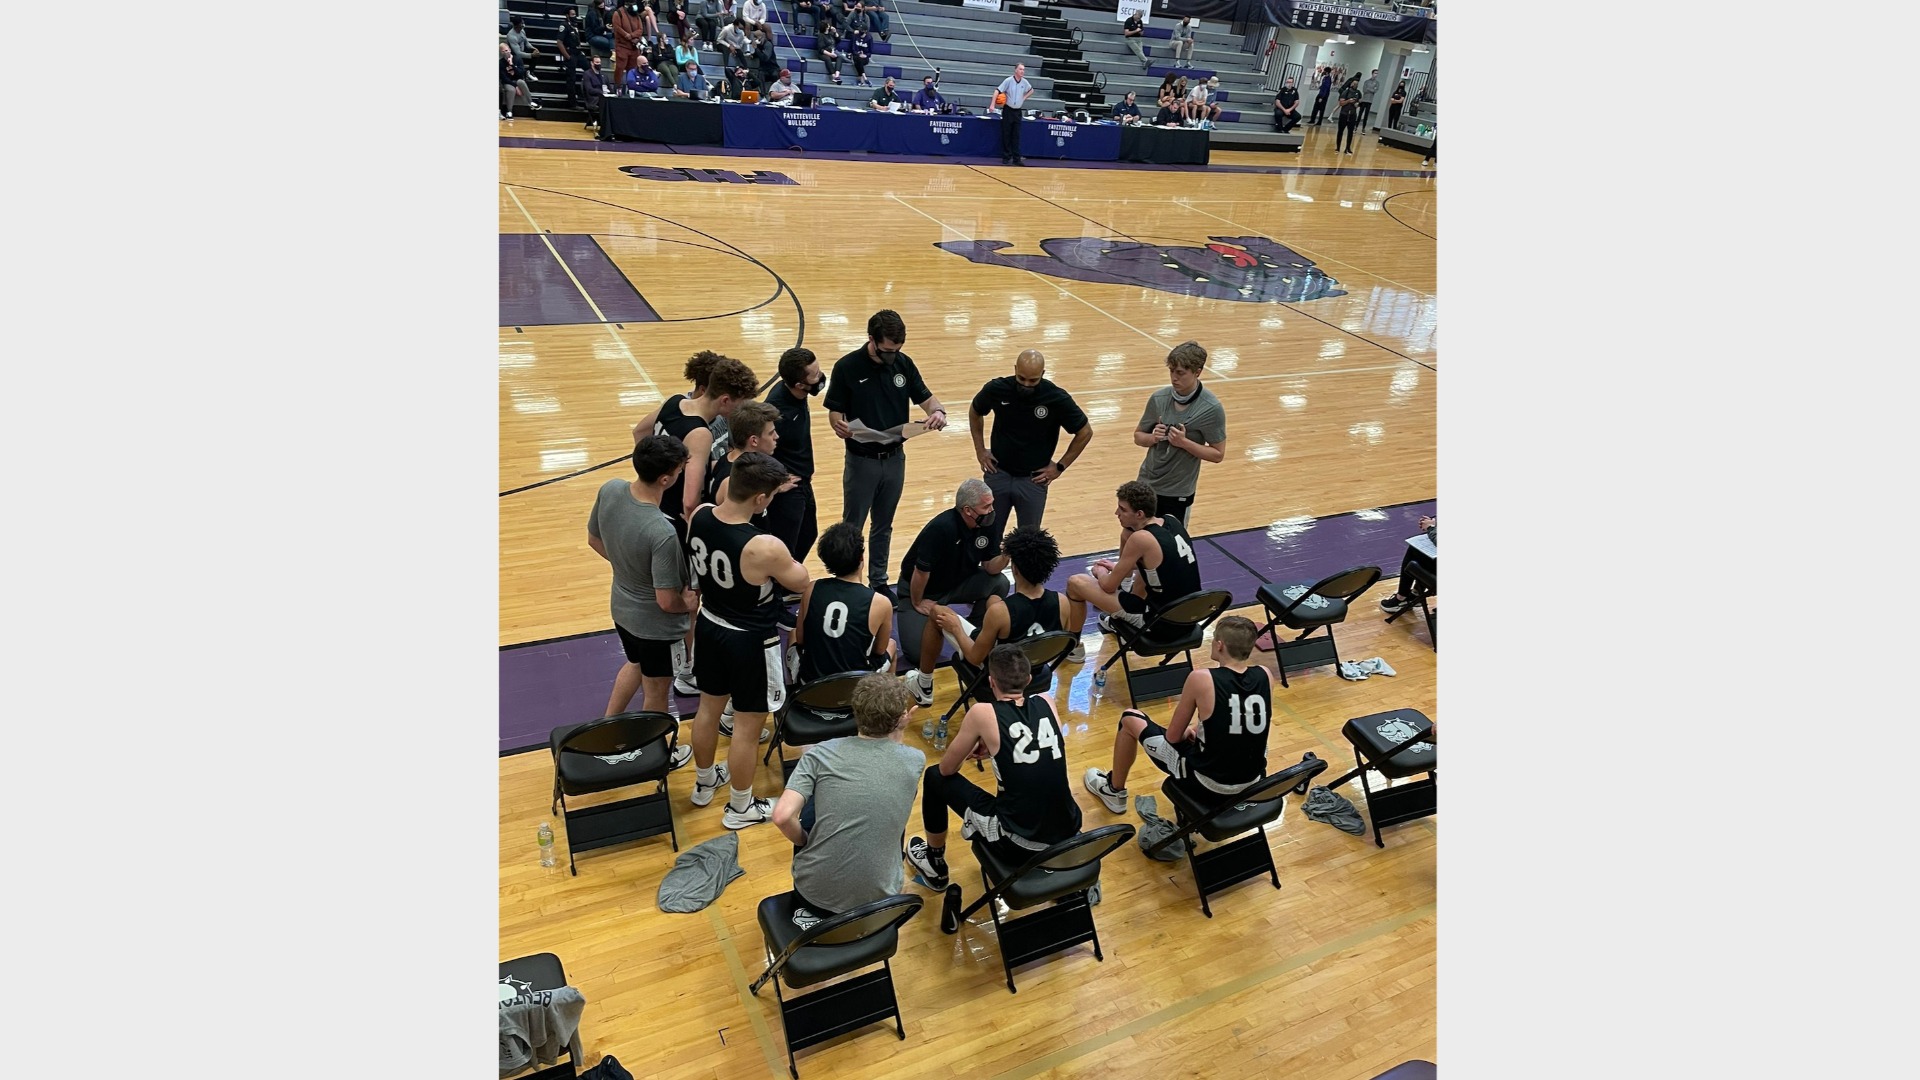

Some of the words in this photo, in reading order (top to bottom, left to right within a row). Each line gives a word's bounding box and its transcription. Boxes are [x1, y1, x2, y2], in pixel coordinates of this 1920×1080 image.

[1120, 7, 1147, 17] SECTN
[1048, 124, 1077, 132] FAYETTEVILLE
[690, 537, 734, 589] 30
[1174, 534, 1195, 564] 4
[823, 601, 848, 638] 0
[773, 689, 781, 701] B
[1229, 693, 1267, 734] 10
[1009, 717, 1062, 764] 24
[499, 990, 552, 1009] BENTO
